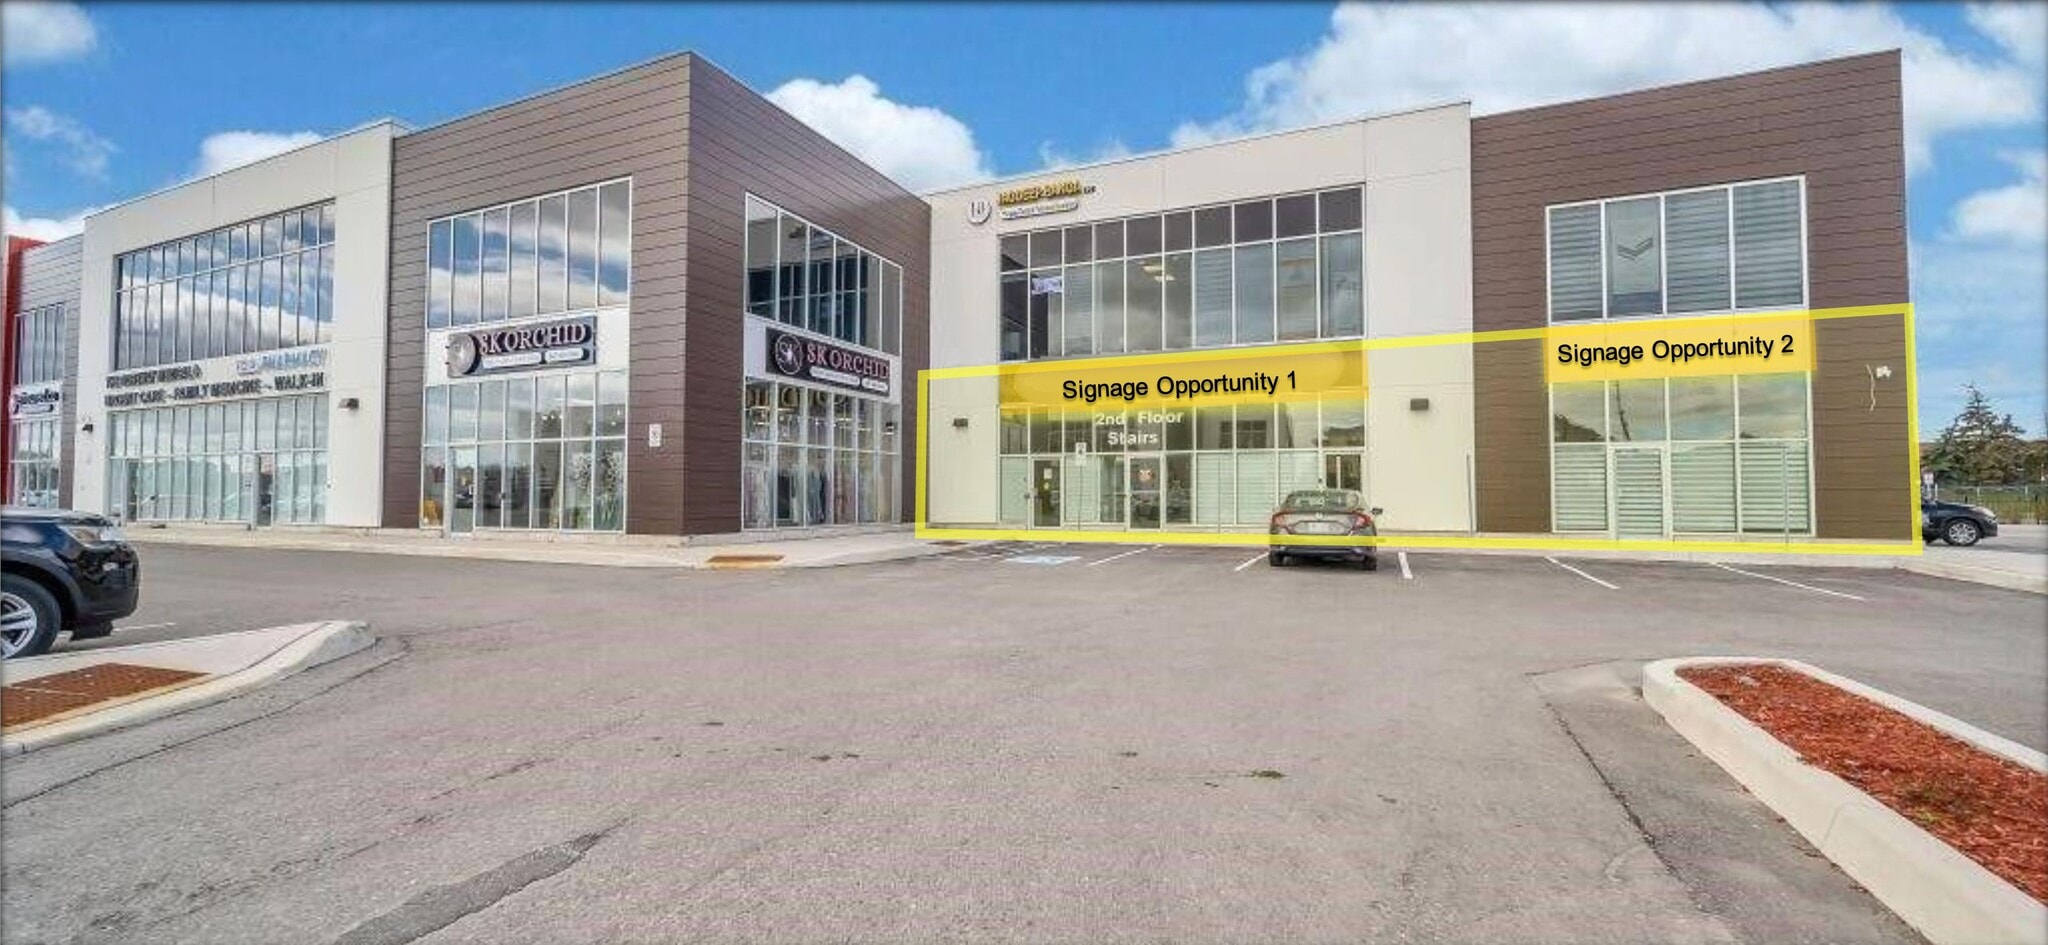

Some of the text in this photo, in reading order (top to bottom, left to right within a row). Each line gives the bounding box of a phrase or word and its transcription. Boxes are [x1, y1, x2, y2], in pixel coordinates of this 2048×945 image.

[479, 322, 587, 354] SK ORCHID
[806, 342, 828, 366] SK
[829, 349, 889, 379] ORCHID
[1096, 410, 1185, 426] 2nd Floor
[1107, 431, 1158, 446] Stairs
